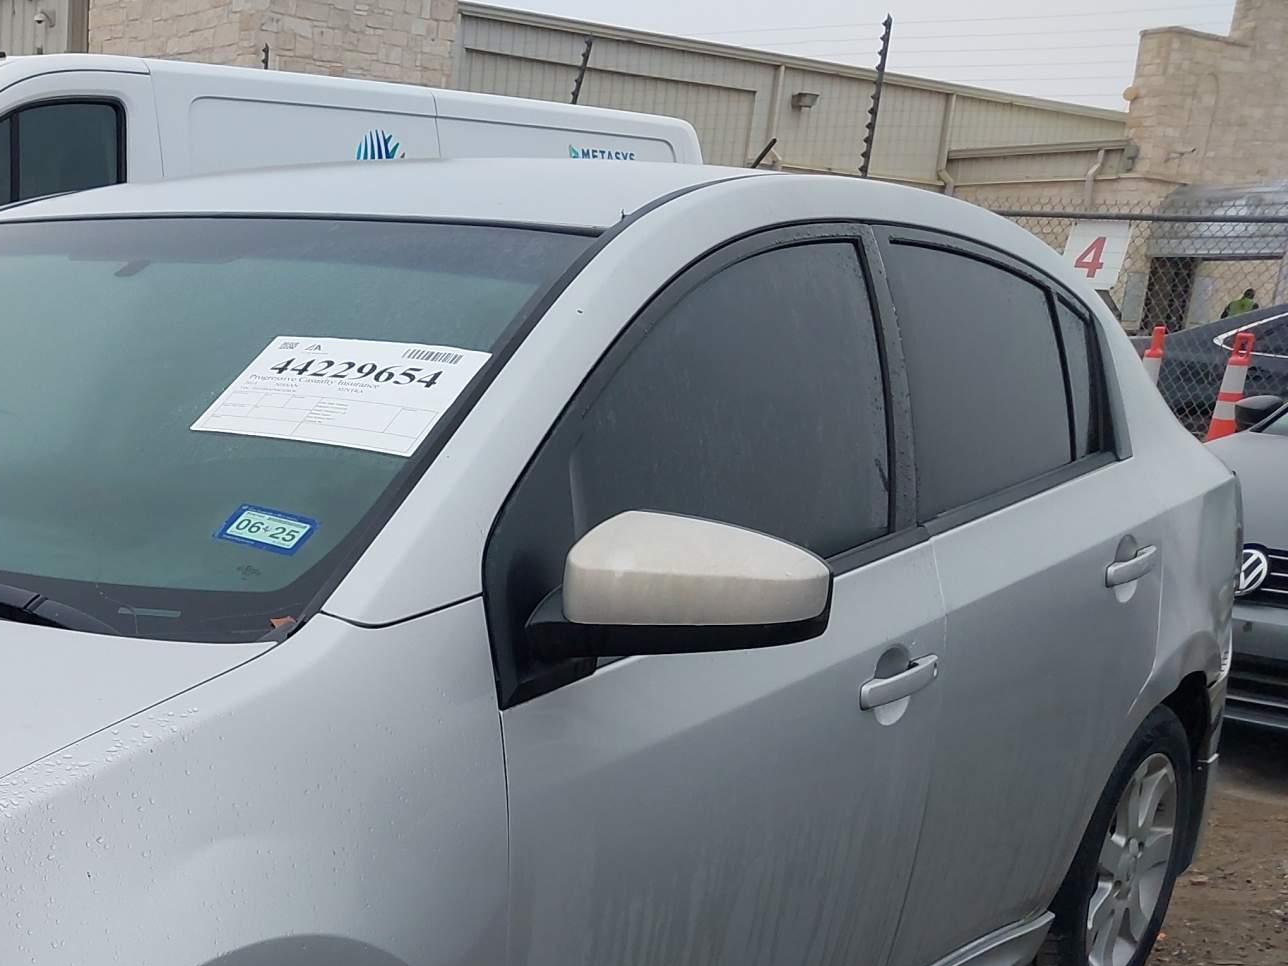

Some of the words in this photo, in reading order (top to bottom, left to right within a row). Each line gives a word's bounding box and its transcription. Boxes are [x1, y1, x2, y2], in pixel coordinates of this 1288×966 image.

[1074, 236, 1107, 278] 4
[270, 358, 444, 388] 44229654
[235, 518, 265, 534] 06
[269, 526, 300, 543] 25
